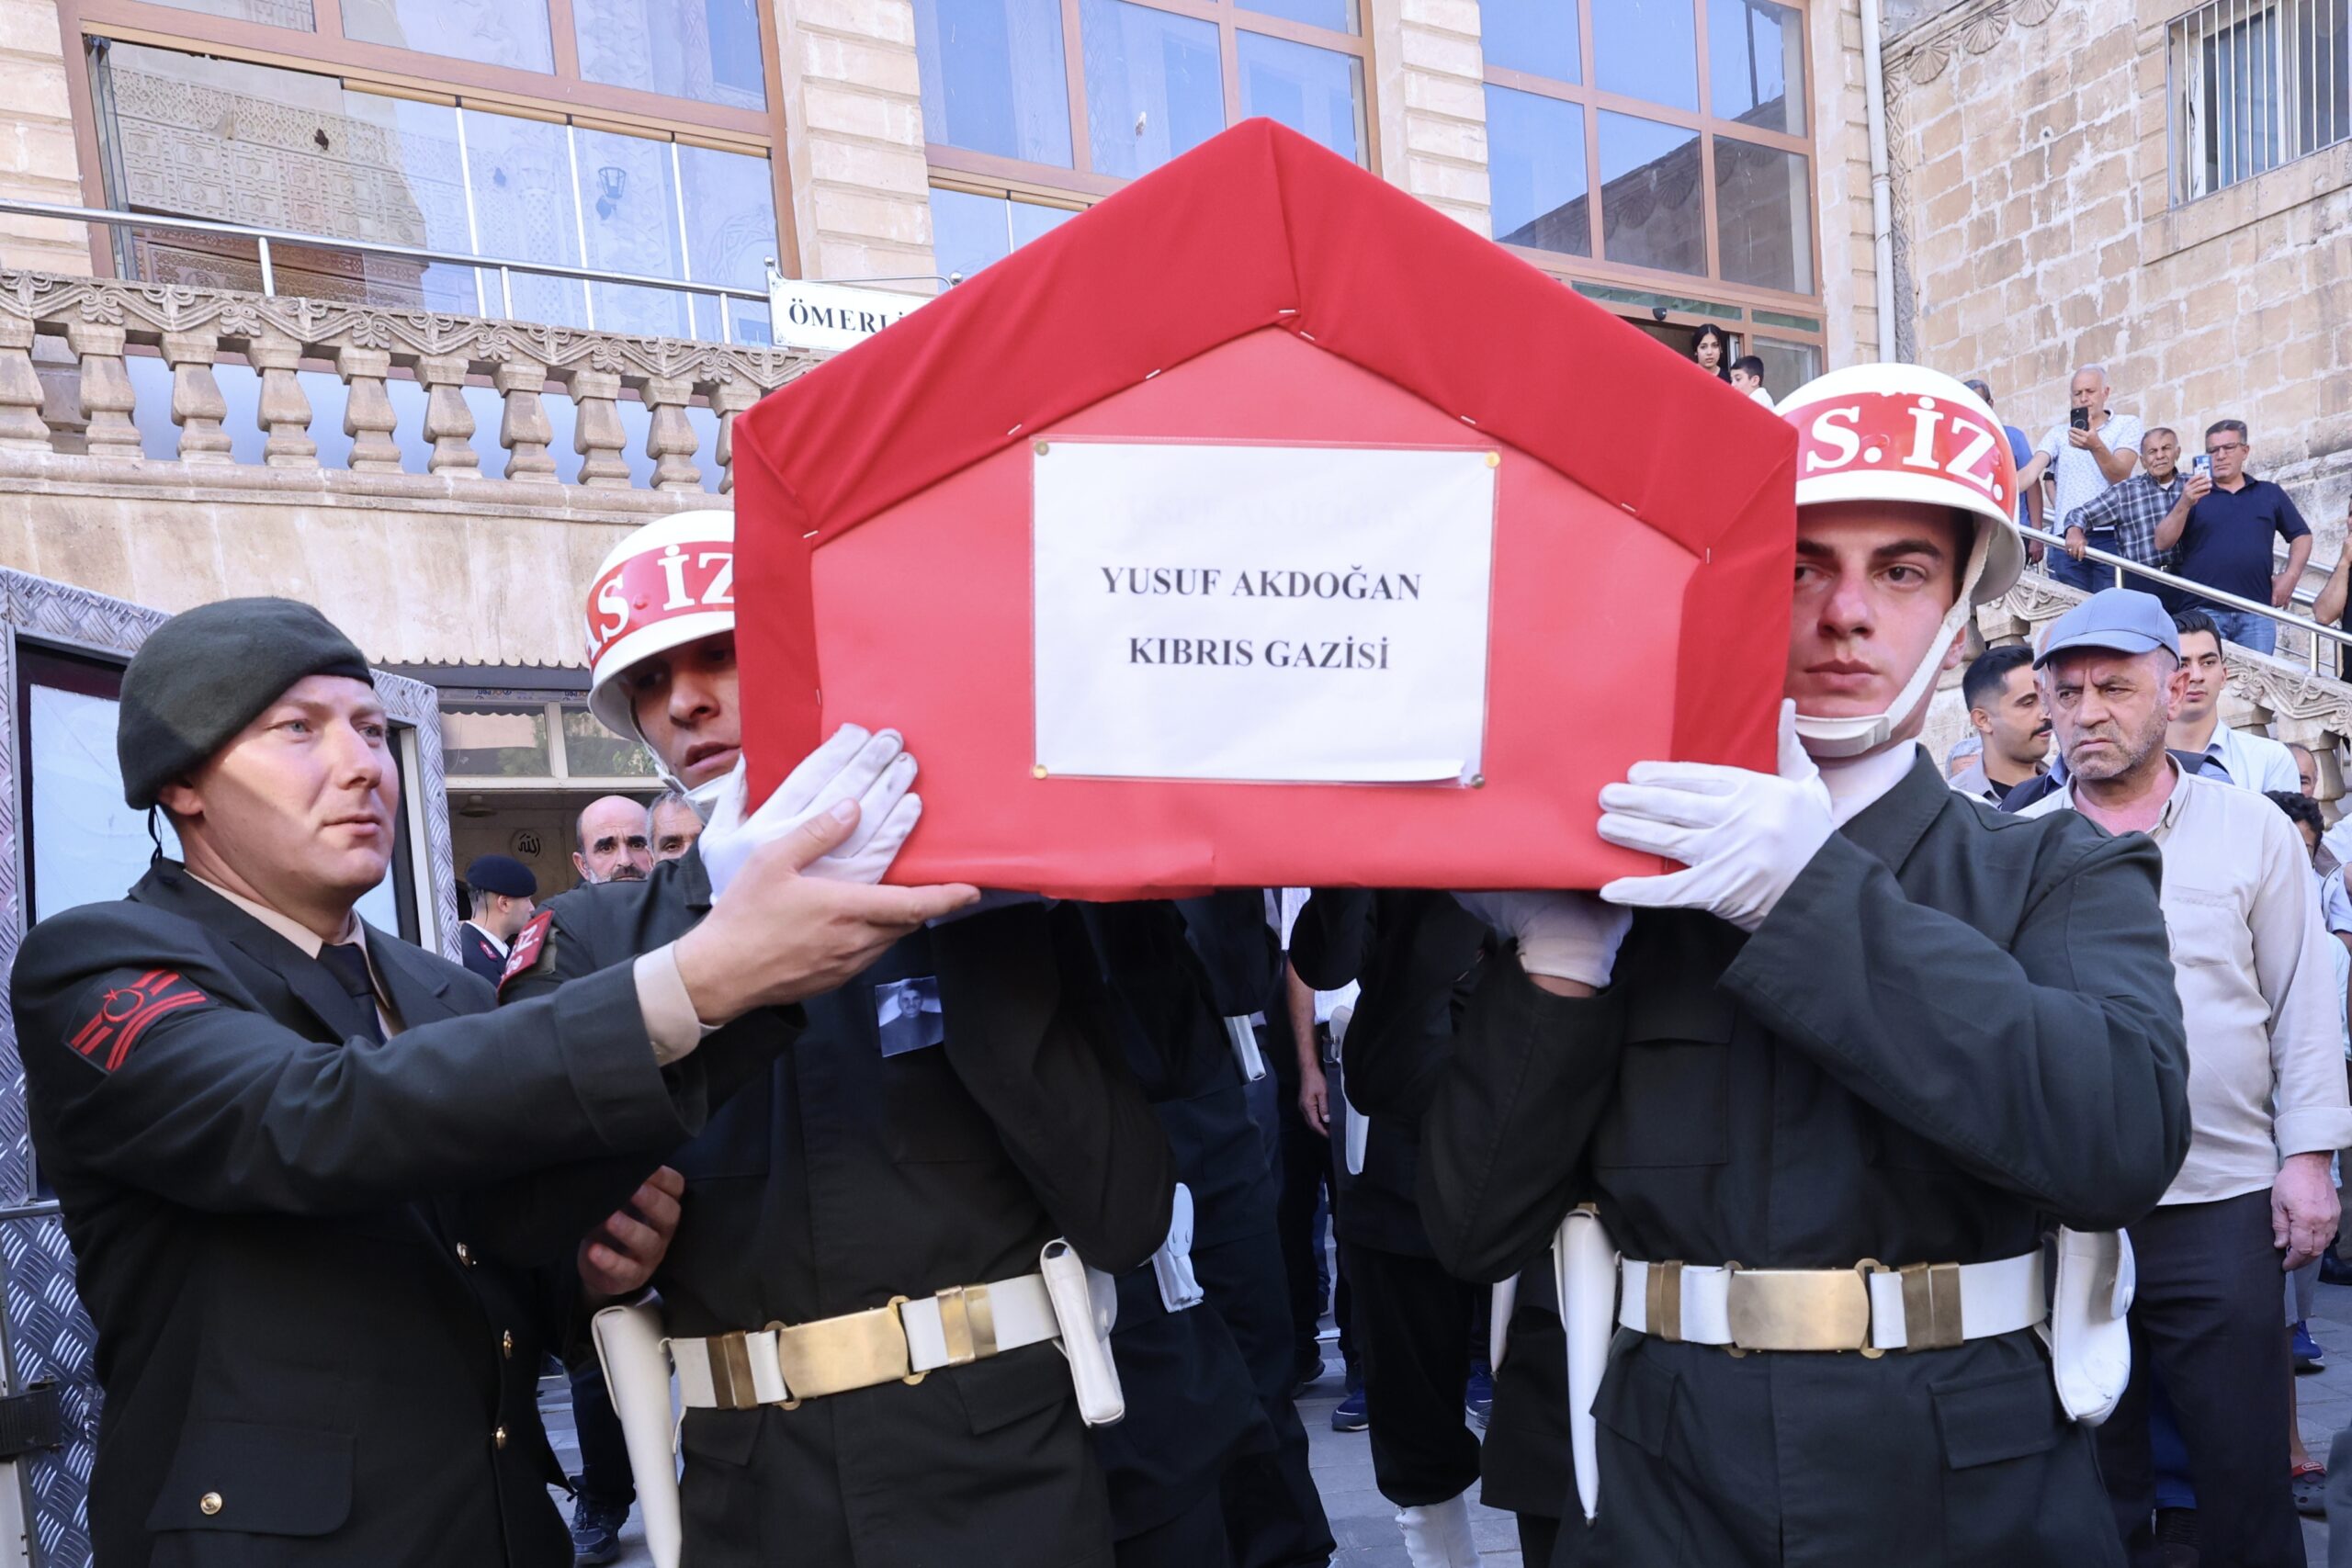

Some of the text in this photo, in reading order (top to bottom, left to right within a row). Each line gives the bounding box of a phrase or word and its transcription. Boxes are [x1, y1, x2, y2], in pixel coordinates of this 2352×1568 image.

[788, 298, 903, 334] ÖMERL
[1101, 565, 1421, 601] YUSUF AKDOĞAN
[1129, 635, 1389, 670] KIBRIS GAZİSİ
